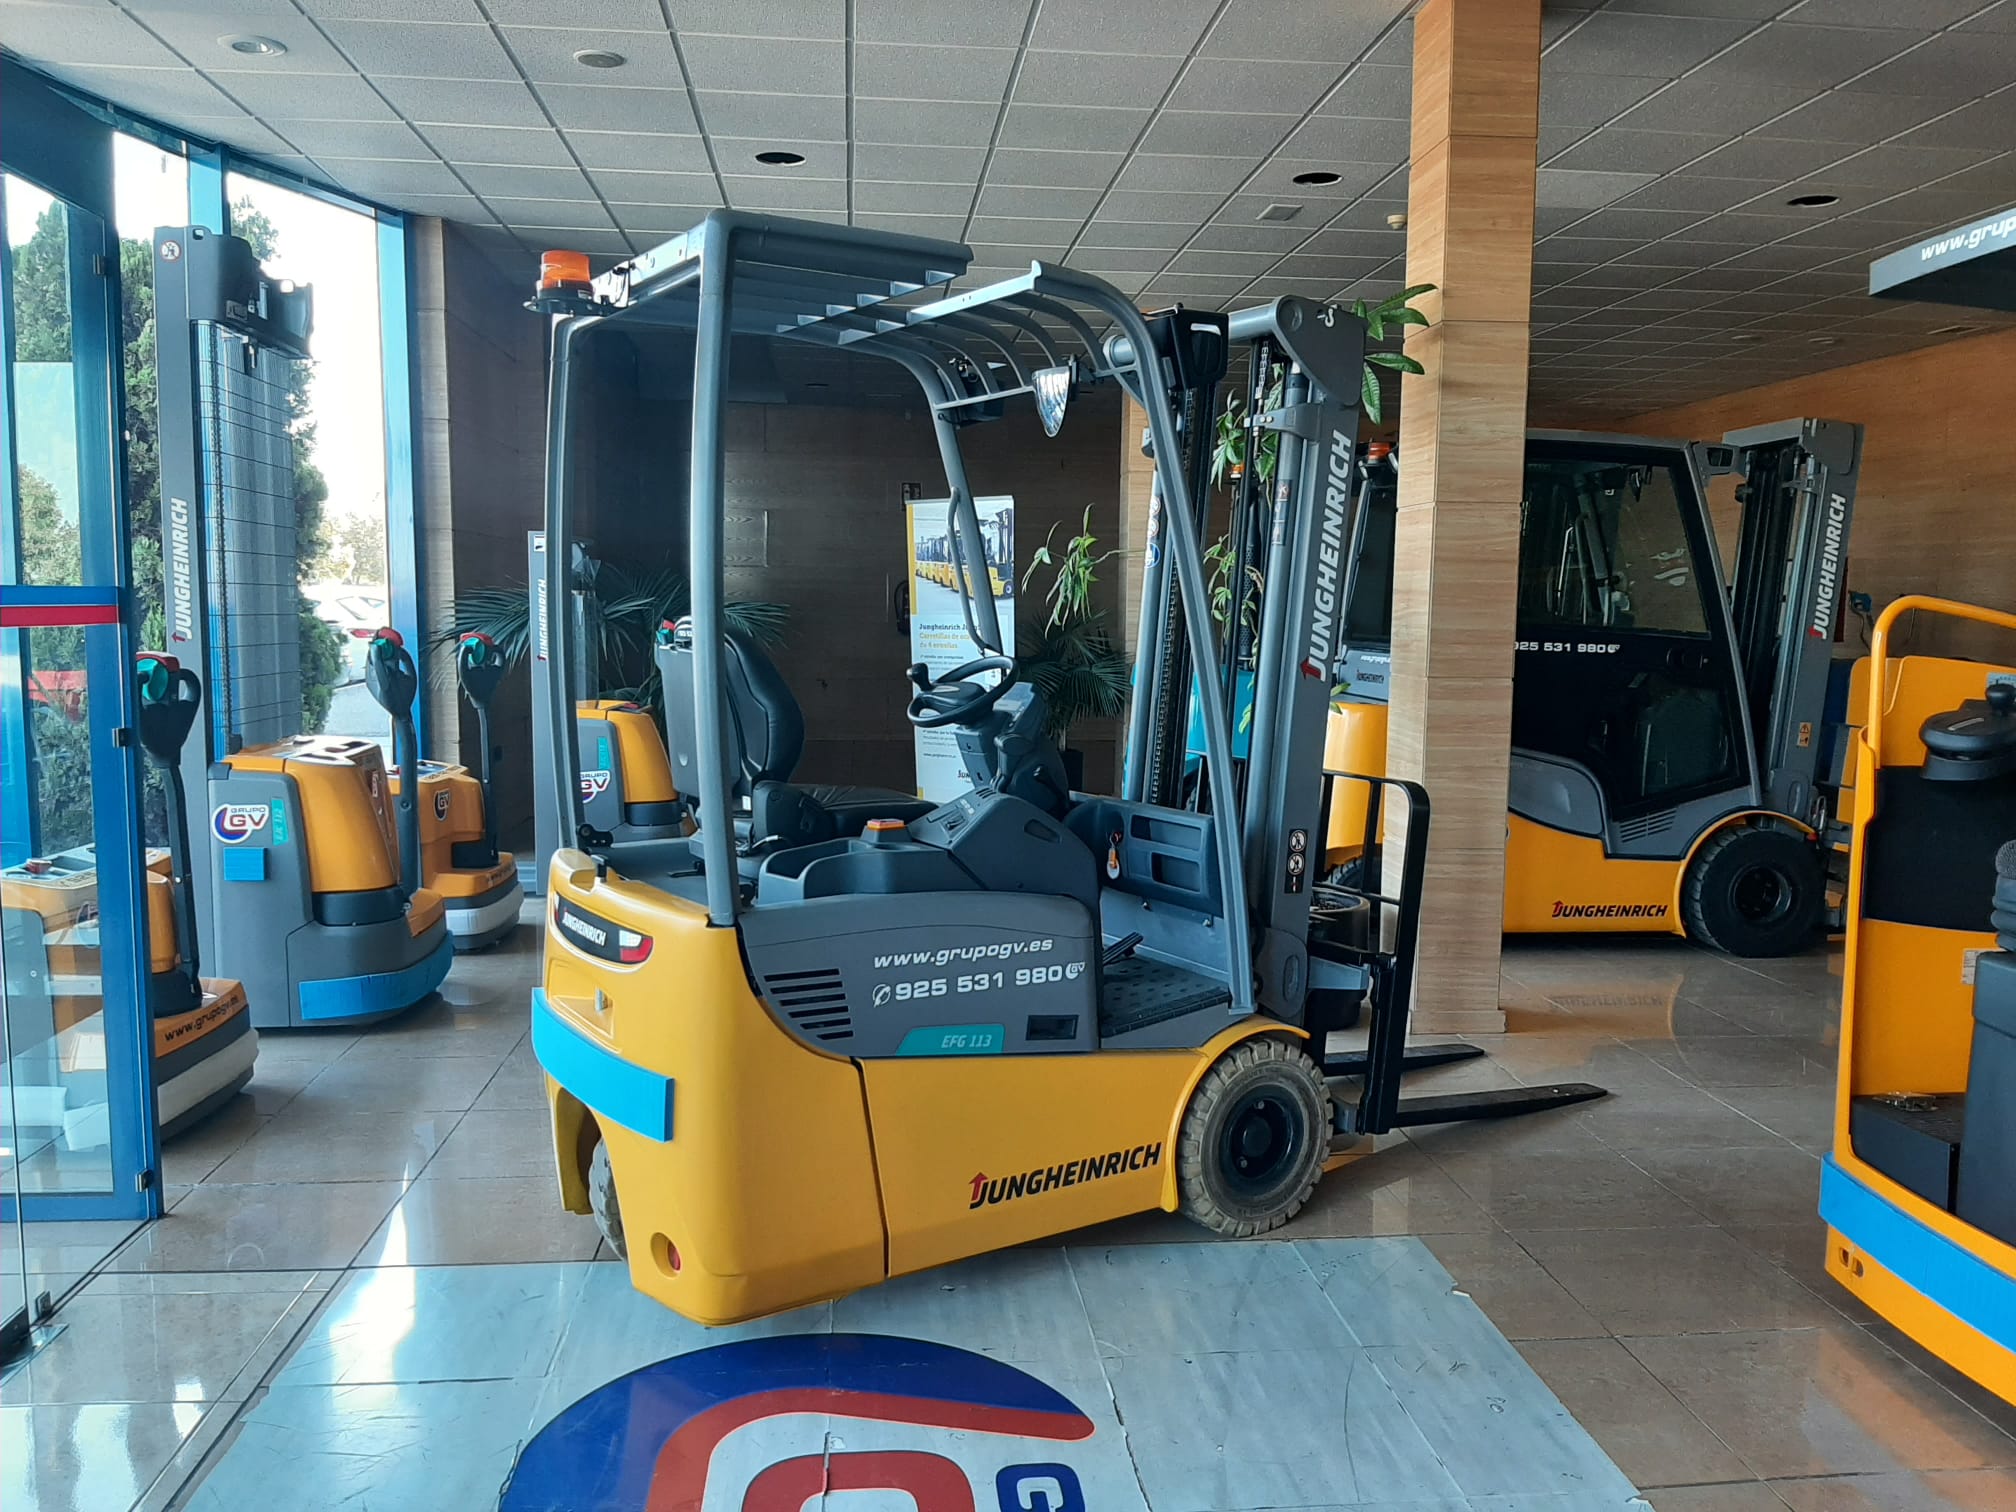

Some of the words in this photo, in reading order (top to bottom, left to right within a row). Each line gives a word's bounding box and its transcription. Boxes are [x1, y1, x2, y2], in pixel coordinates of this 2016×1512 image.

[171, 497, 193, 640] JUNGHEINRICH
[1307, 430, 1351, 682] JUNGHEINRICH
[1812, 493, 1846, 640] JUNGHEINRICH
[919, 623, 960, 631] Jungheinrich
[1543, 642, 1571, 652] 531
[1577, 643, 1606, 653] 980
[230, 814, 265, 827] GV
[1552, 902, 1668, 918] JUNGHEINRICH
[874, 939, 1053, 968] www.grupogv.es
[895, 978, 947, 1000] 925
[957, 972, 1003, 993] 531
[1015, 965, 1062, 986] 980
[941, 1035, 965, 1049] EFG
[968, 1034, 992, 1047] 113
[969, 1141, 1162, 1210] JUNGHEINRICH
